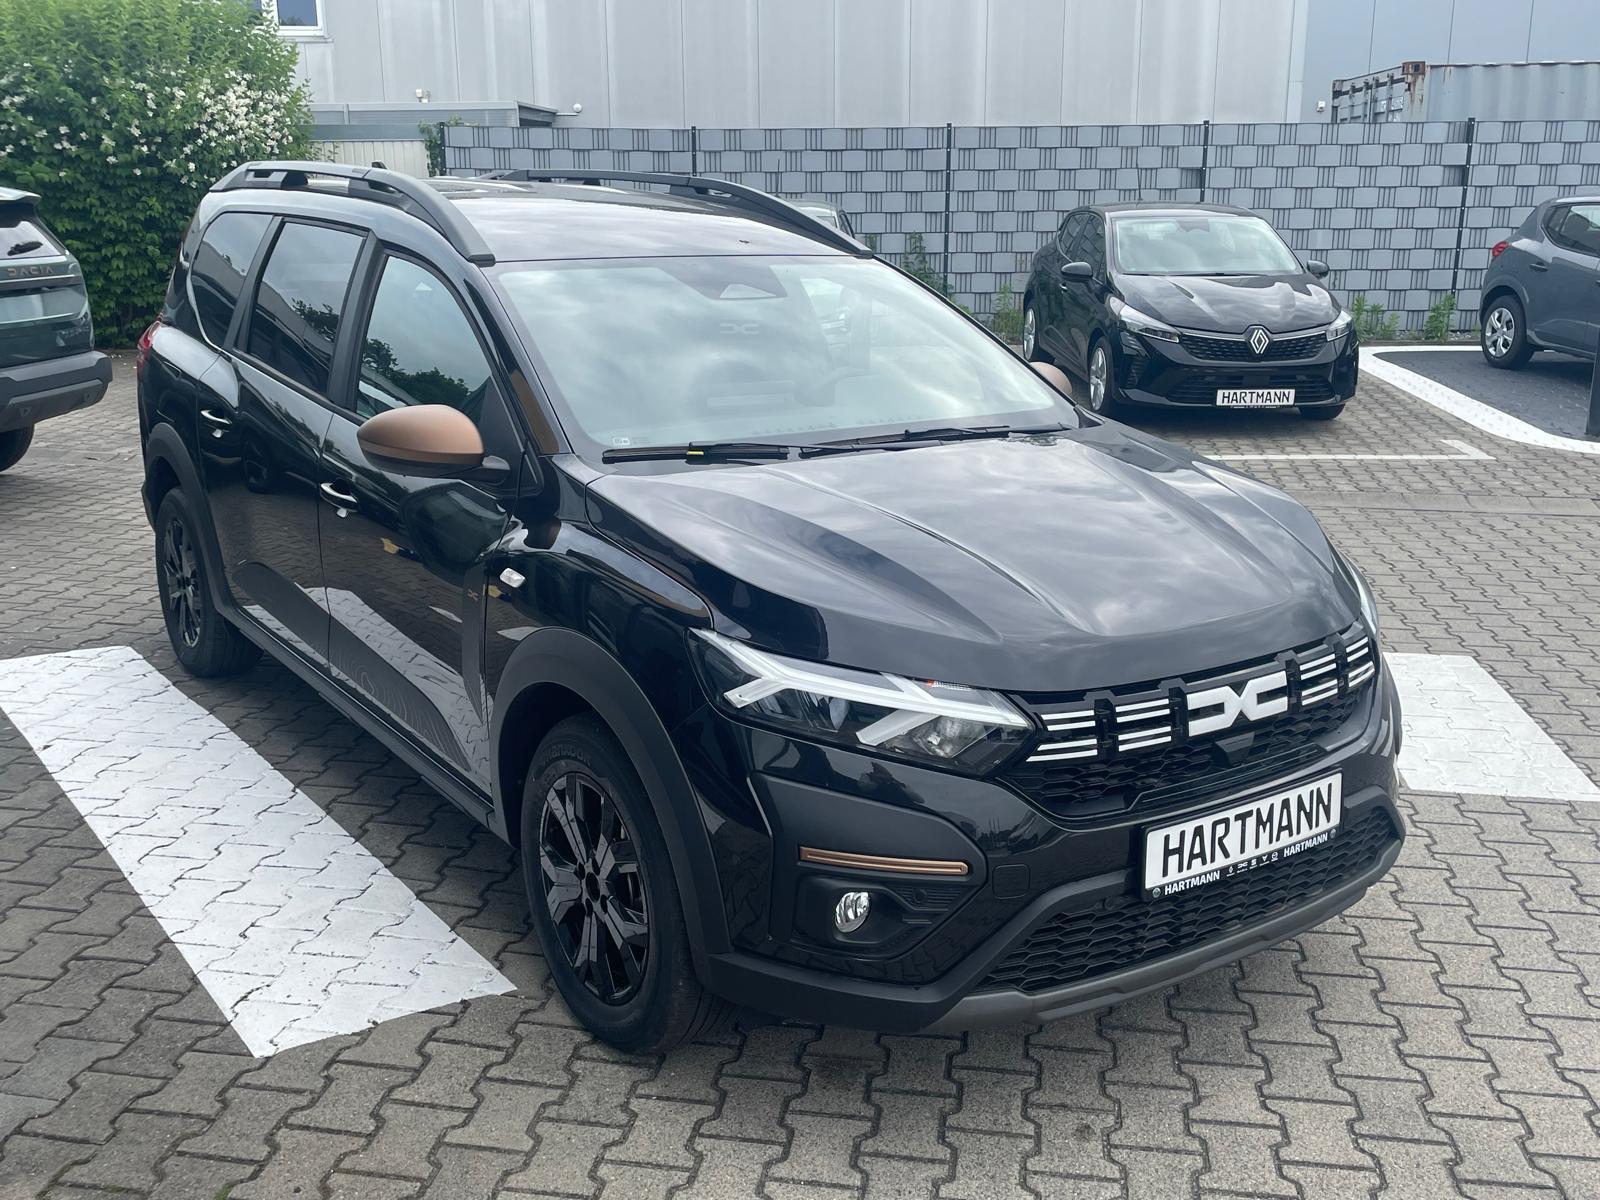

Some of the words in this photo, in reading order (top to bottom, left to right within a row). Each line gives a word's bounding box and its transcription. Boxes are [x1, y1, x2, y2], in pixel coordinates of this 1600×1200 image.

[7, 266, 54, 277] DACIA
[1222, 391, 1291, 404] HARTMANN
[1162, 782, 1332, 878] HARTMANN
[1165, 870, 1220, 896] HARTMANN
[1283, 832, 1328, 858] HARTMANN
